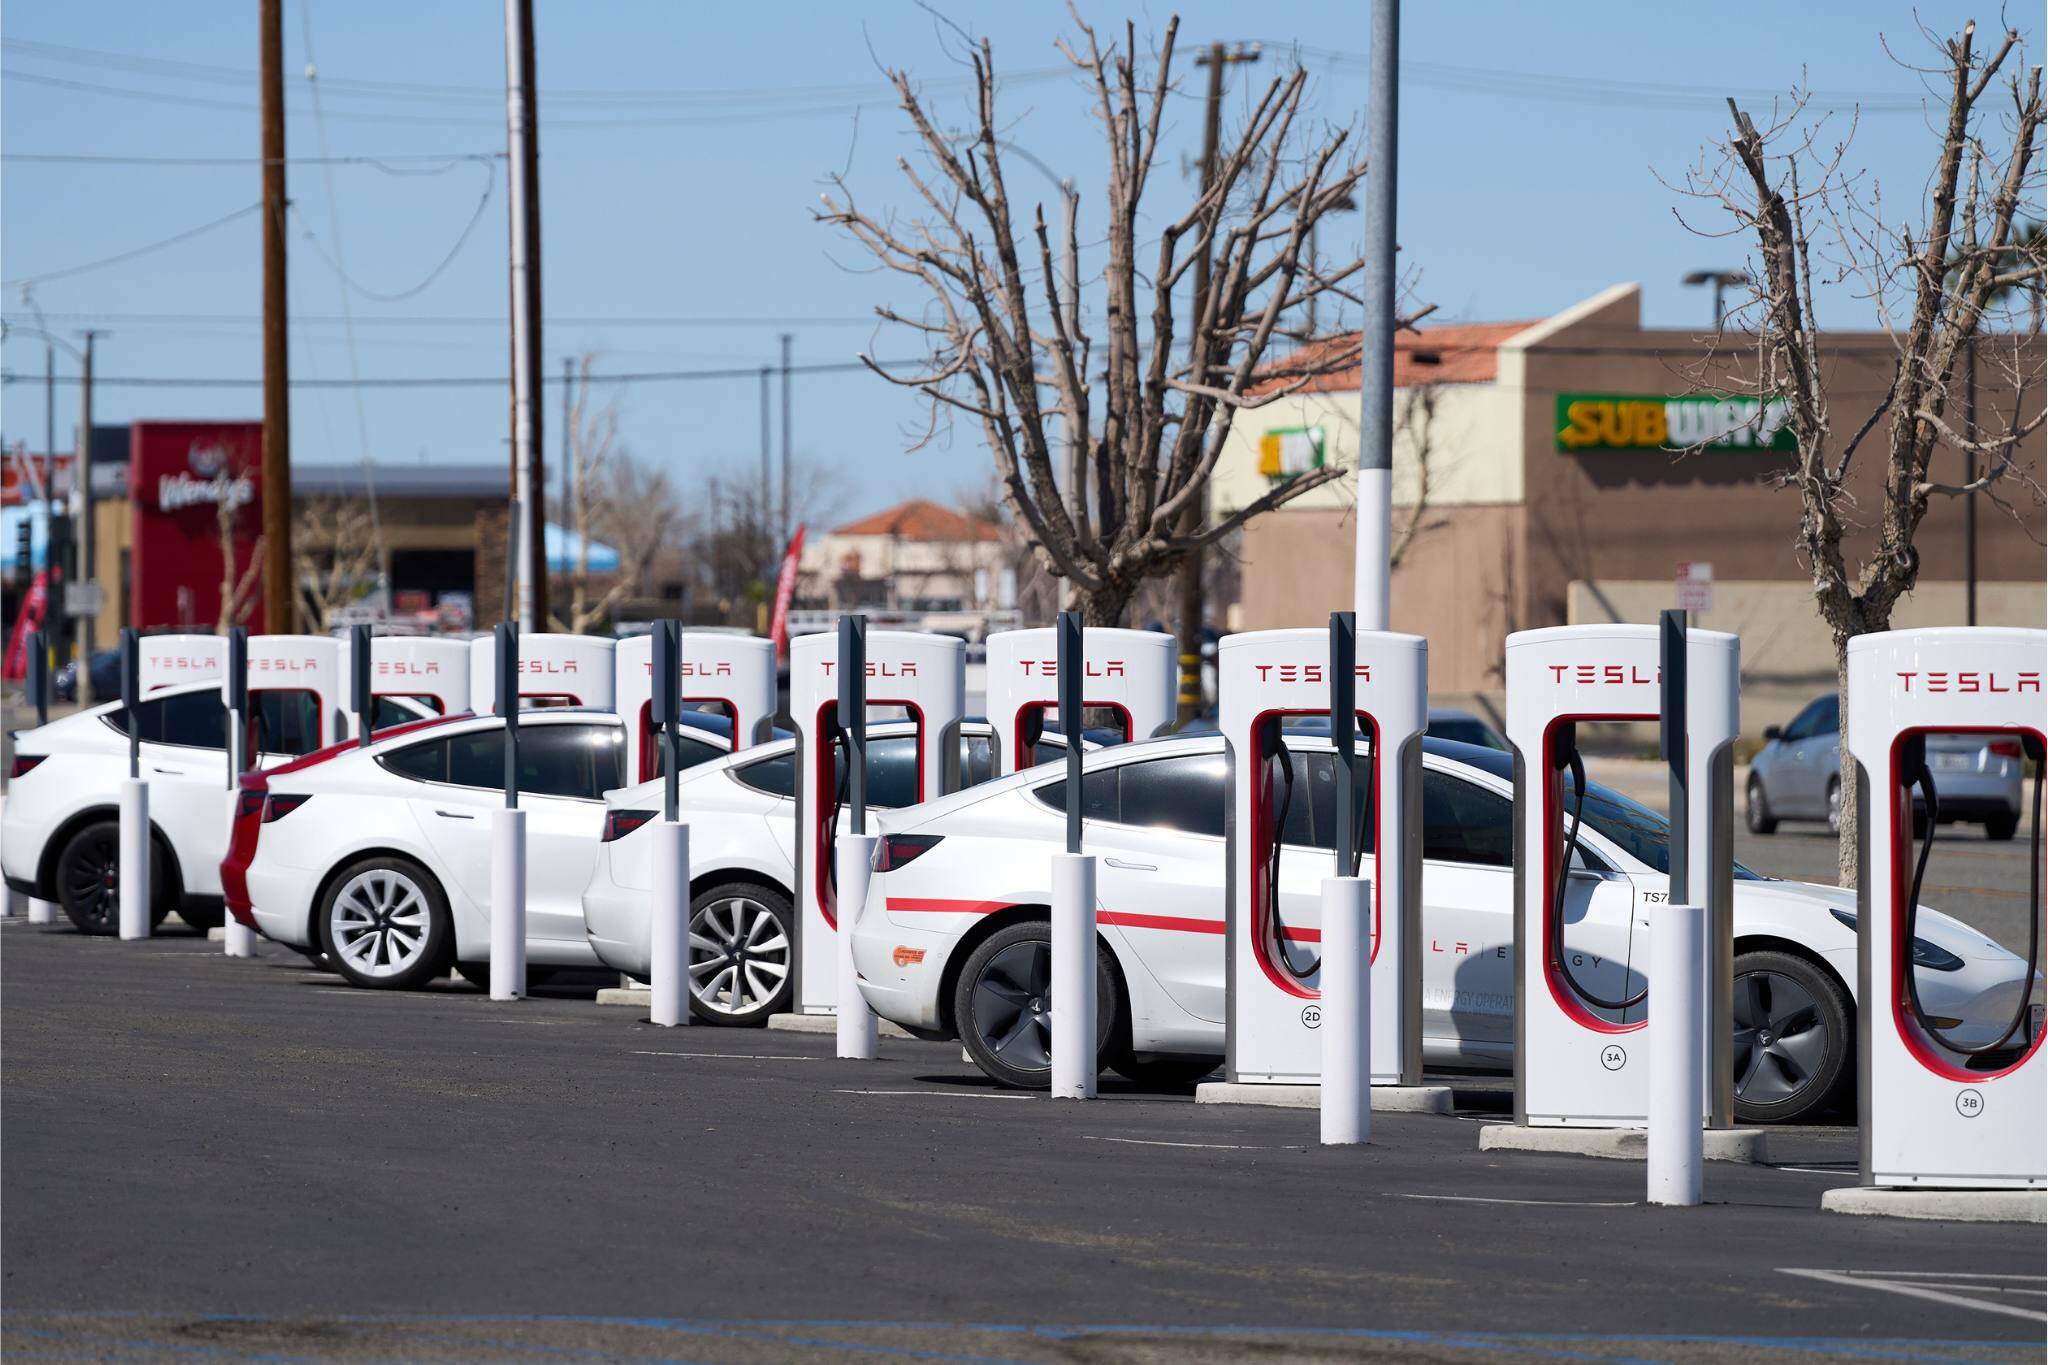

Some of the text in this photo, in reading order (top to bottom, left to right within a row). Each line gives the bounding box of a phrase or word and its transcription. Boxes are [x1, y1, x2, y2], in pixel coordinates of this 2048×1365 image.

[1561, 400, 1794, 447] SUBWAY
[150, 657, 217, 668] TESLA
[372, 662, 439, 674] ESLA
[518, 661, 577, 673] ESLA
[1019, 660, 1124, 677] TELA
[644, 663, 731, 676] TSLA
[821, 662, 917, 677] TSLA
[1255, 665, 1370, 682] TESA
[1548, 665, 1661, 684] TESL
[1896, 672, 2041, 693] TESLA
[1643, 892, 1672, 903] TS7
[1305, 1011, 1320, 1021] 2D
[1607, 1053, 1620, 1061] 3A
[1963, 1097, 1977, 1107] 3B
